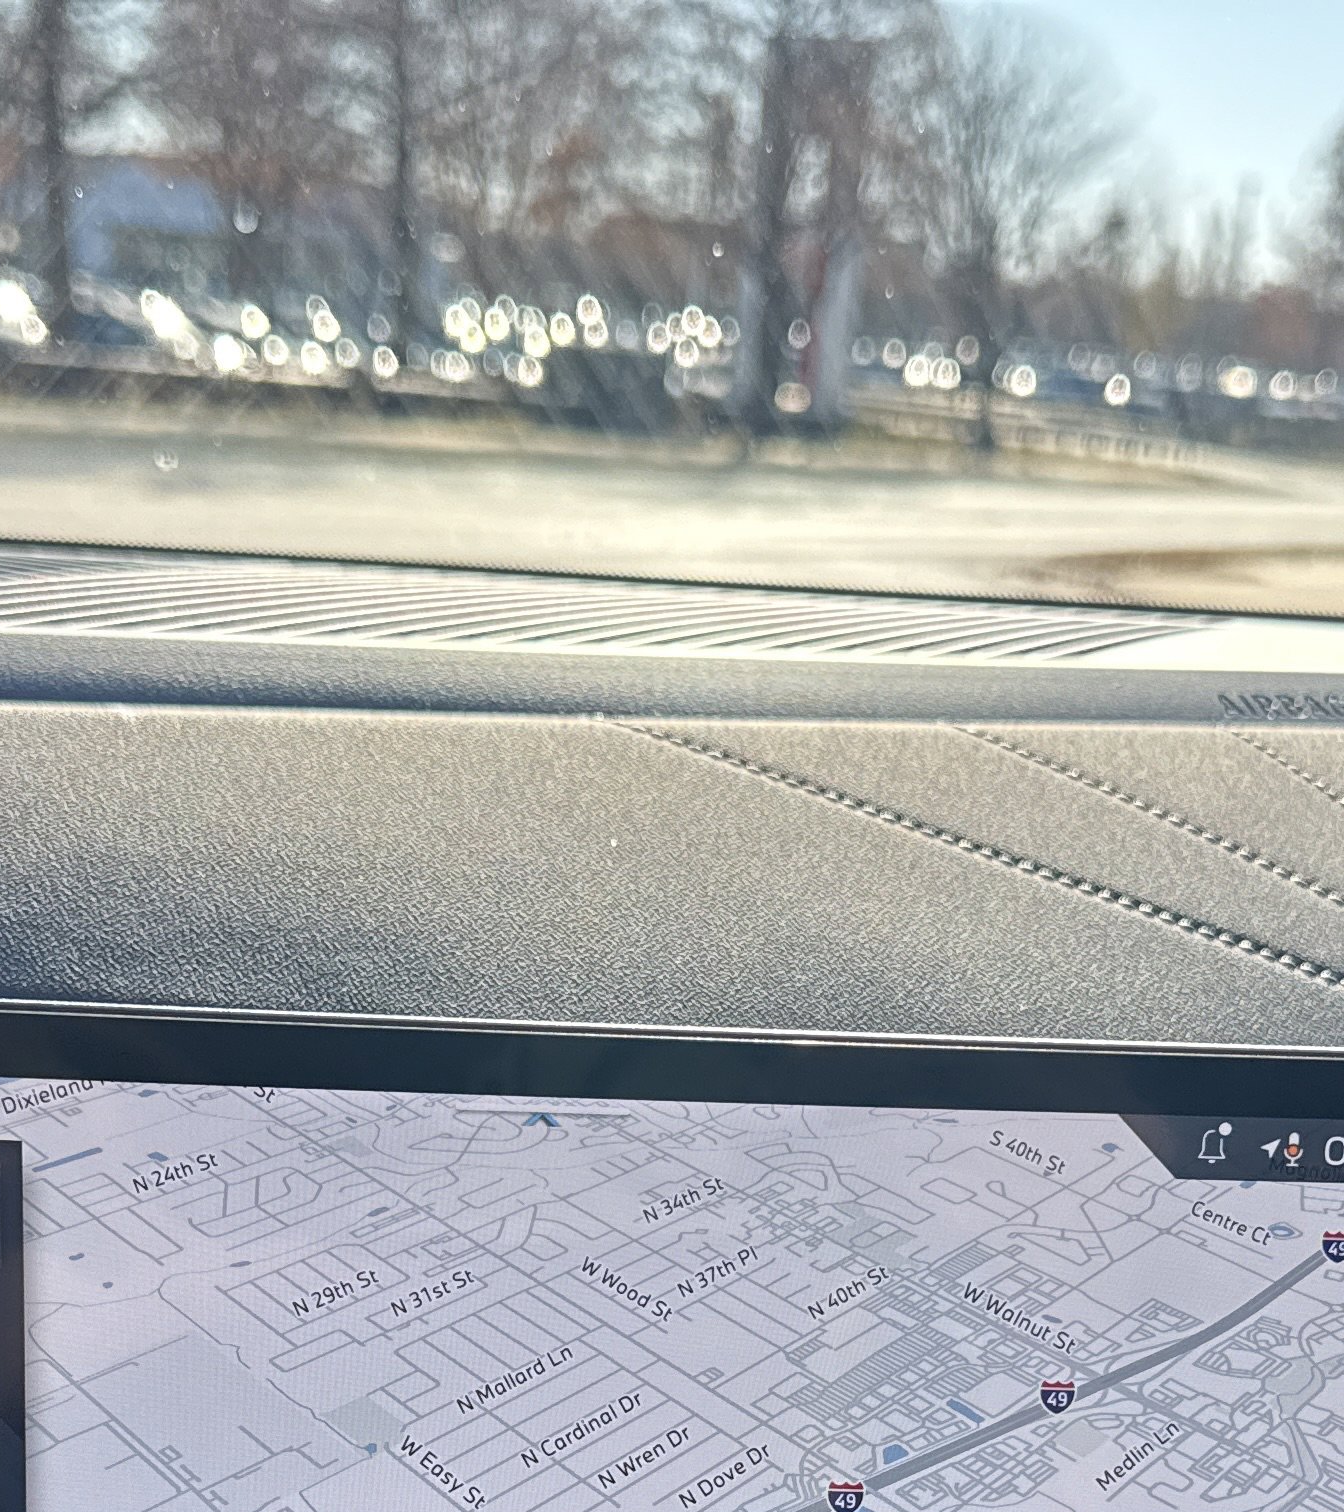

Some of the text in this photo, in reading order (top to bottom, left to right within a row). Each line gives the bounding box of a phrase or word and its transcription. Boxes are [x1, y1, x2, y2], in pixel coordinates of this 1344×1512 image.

[0, 1079, 94, 1115] Dixieland
[132, 1153, 218, 1194] N 24th St
[989, 1130, 1066, 1177] S 40th St
[642, 1177, 724, 1223] N 34th St
[1191, 1200, 1271, 1246] Centre Ct
[292, 1270, 379, 1317] N 29th St
[390, 1270, 475, 1317] N 31st St
[581, 1256, 673, 1322] W Wood St
[677, 1245, 758, 1298] N 37th Pl
[807, 1267, 890, 1320] N 40th St
[964, 1281, 1076, 1355] W Walnut St
[456, 1347, 573, 1415] N Mallard Ln
[1046, 1391, 1068, 1407] 49
[520, 1393, 641, 1468] N Cardinal Dr
[400, 1435, 486, 1510] W Easy St
[597, 1427, 689, 1489] N Wren Dr
[678, 1444, 769, 1509] N Dove Dr
[1095, 1423, 1180, 1492] Medlin Ln
[834, 1493, 857, 1509] 49
